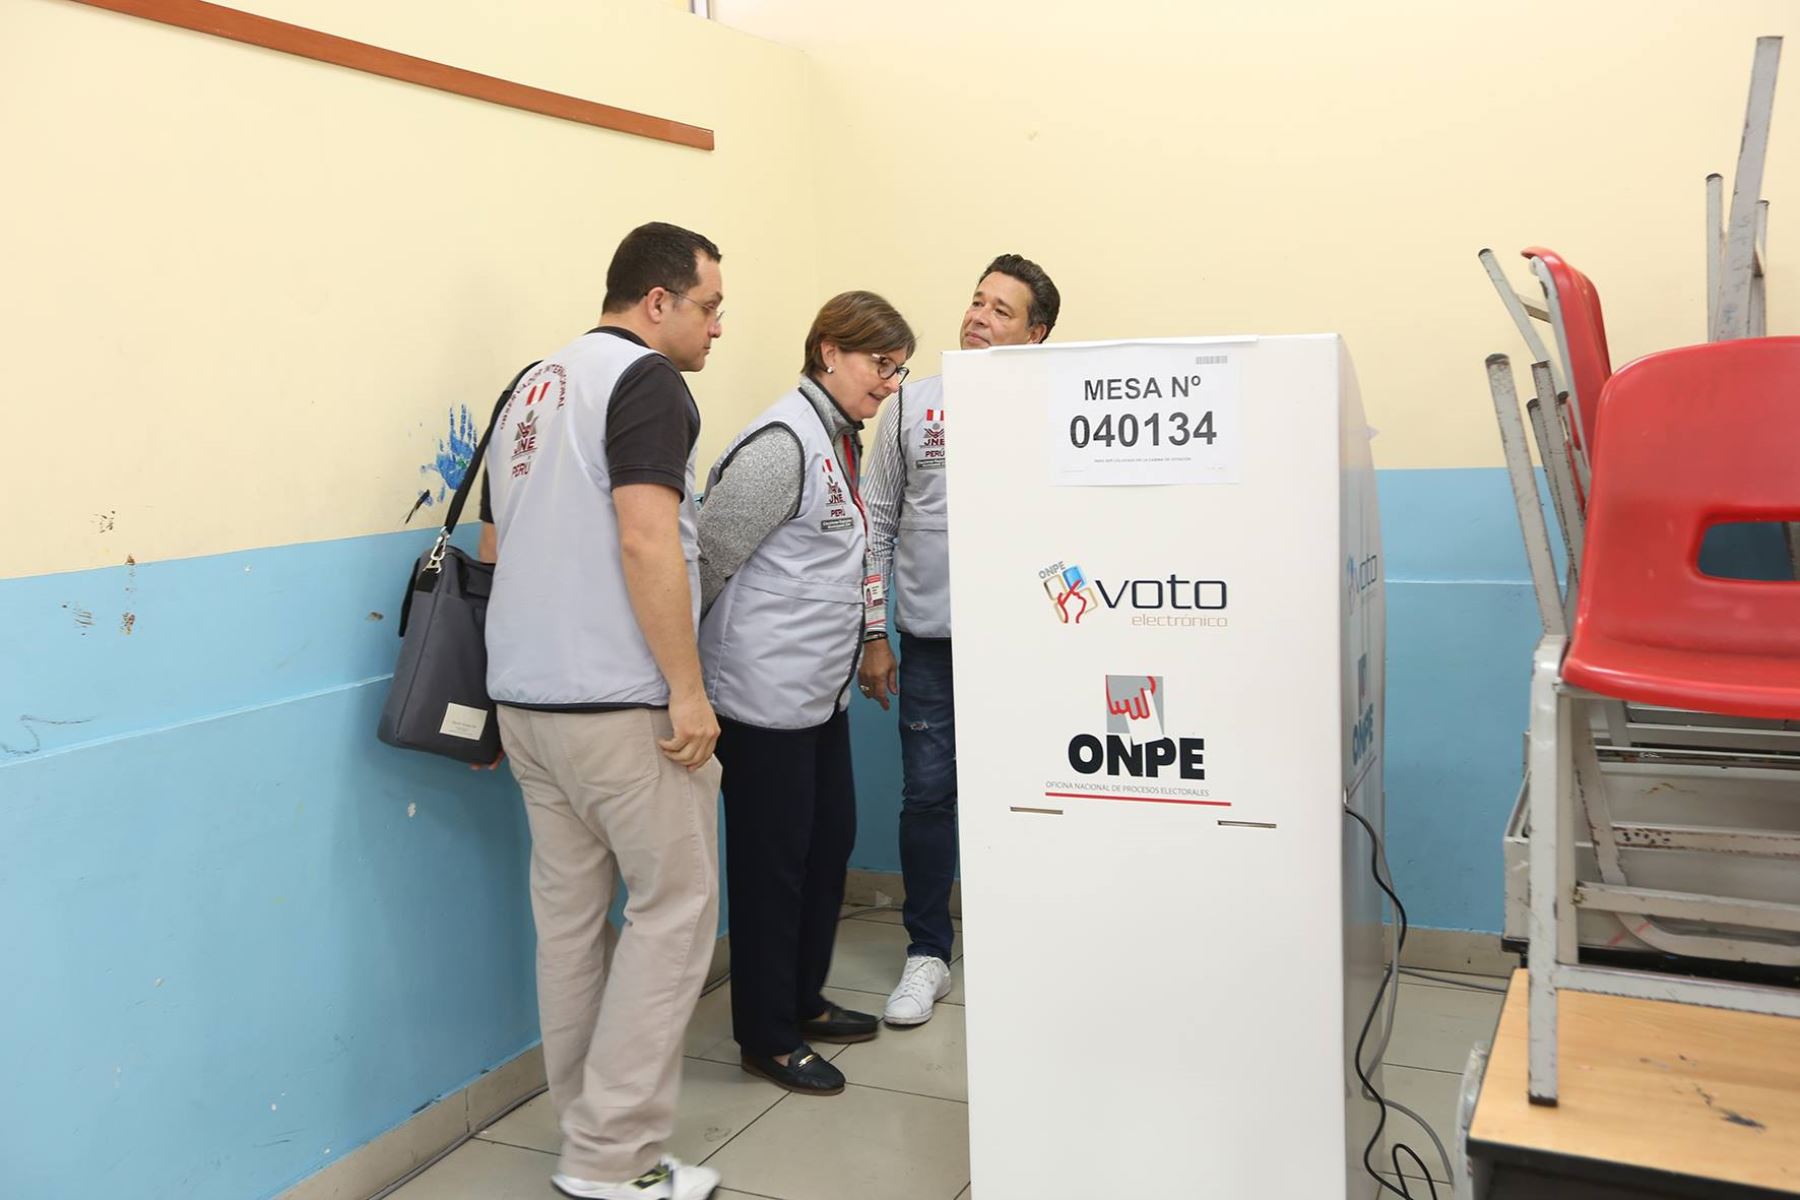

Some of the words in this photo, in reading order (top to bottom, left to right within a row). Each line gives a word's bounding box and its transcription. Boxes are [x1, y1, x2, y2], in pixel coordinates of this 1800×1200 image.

[1084, 377, 1163, 401] MESA
[1069, 411, 1217, 449] 040134
[514, 436, 536, 454] JNE
[829, 494, 844, 504] JNE
[1038, 560, 1066, 579] ONPE
[1095, 574, 1227, 610] voto
[1131, 613, 1229, 628] electrónico
[1067, 733, 1206, 780] ONPE
[1045, 780, 1073, 790] OFICINA
[1075, 782, 1110, 792] NACIONAL
[1111, 784, 1121, 793] DE
[1122, 784, 1160, 795] PROCESOS
[1161, 787, 1210, 797] ELECTORALES
